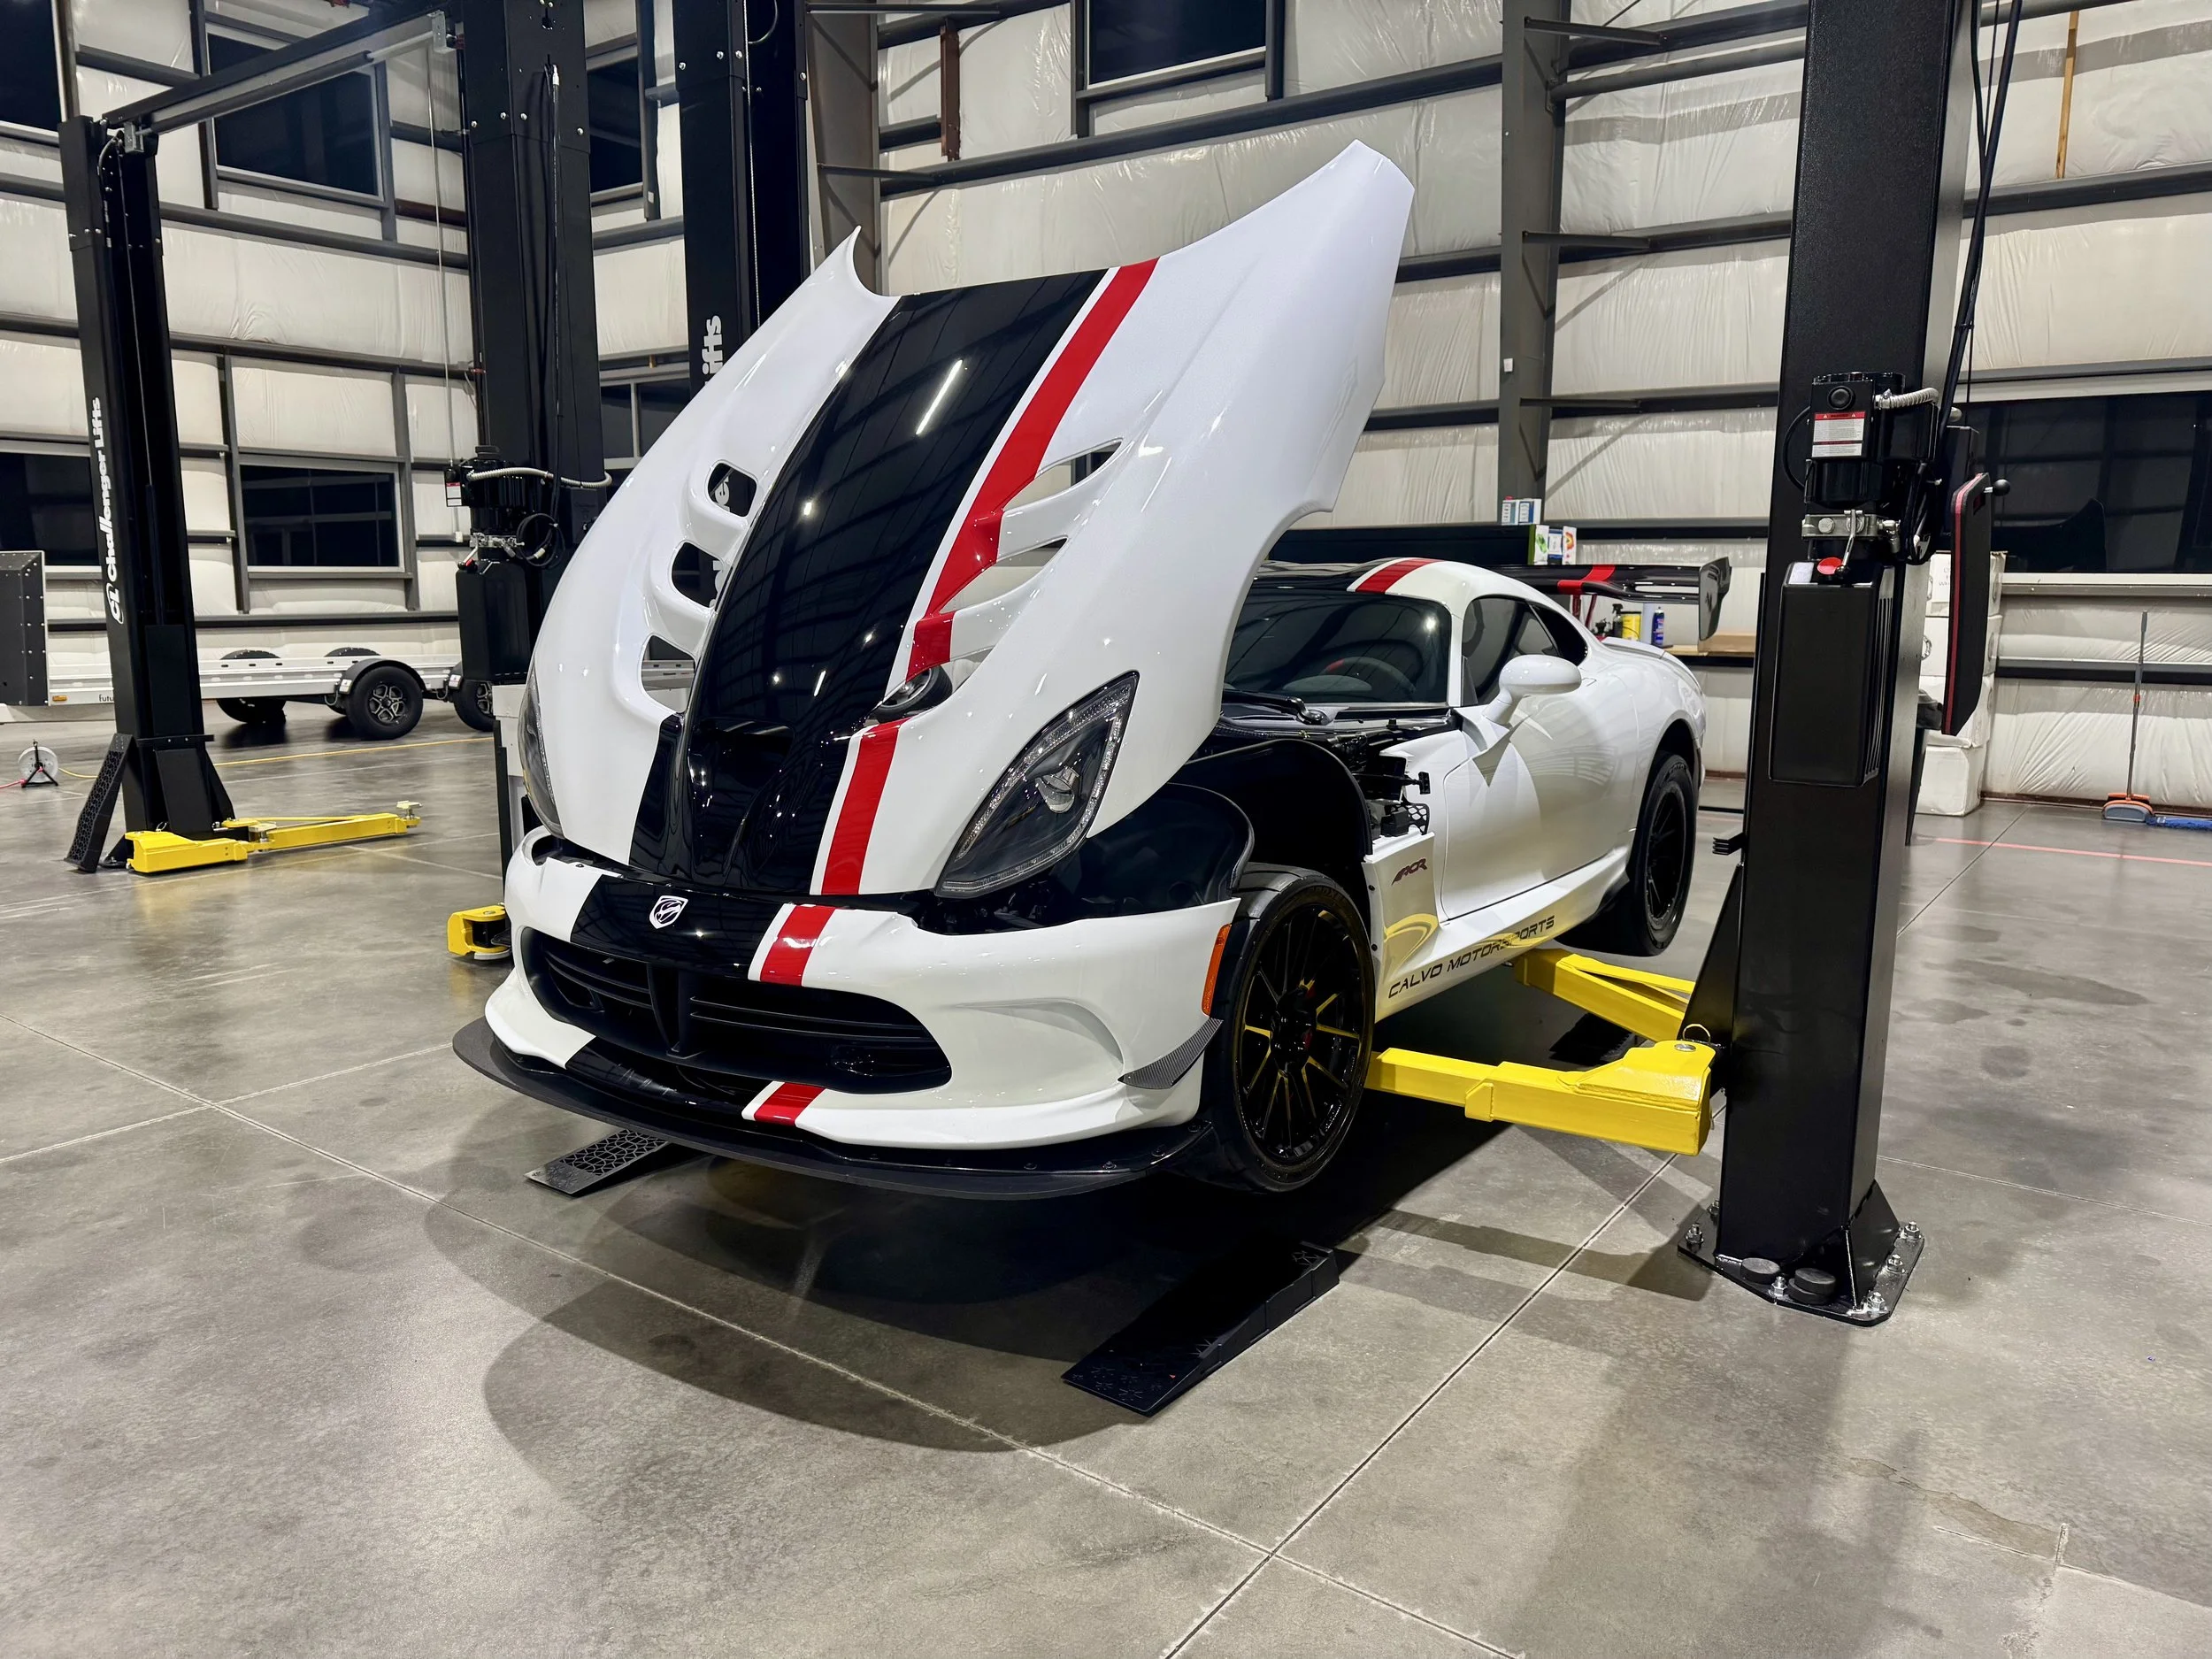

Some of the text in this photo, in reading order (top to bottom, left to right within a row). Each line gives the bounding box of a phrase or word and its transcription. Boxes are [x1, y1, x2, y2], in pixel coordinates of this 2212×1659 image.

[702, 315, 723, 384] ifts
[91, 397, 104, 448] Lifts
[97, 450, 117, 582] Challenger
[1388, 915, 1555, 998] CALVO MOTORSPORTS
